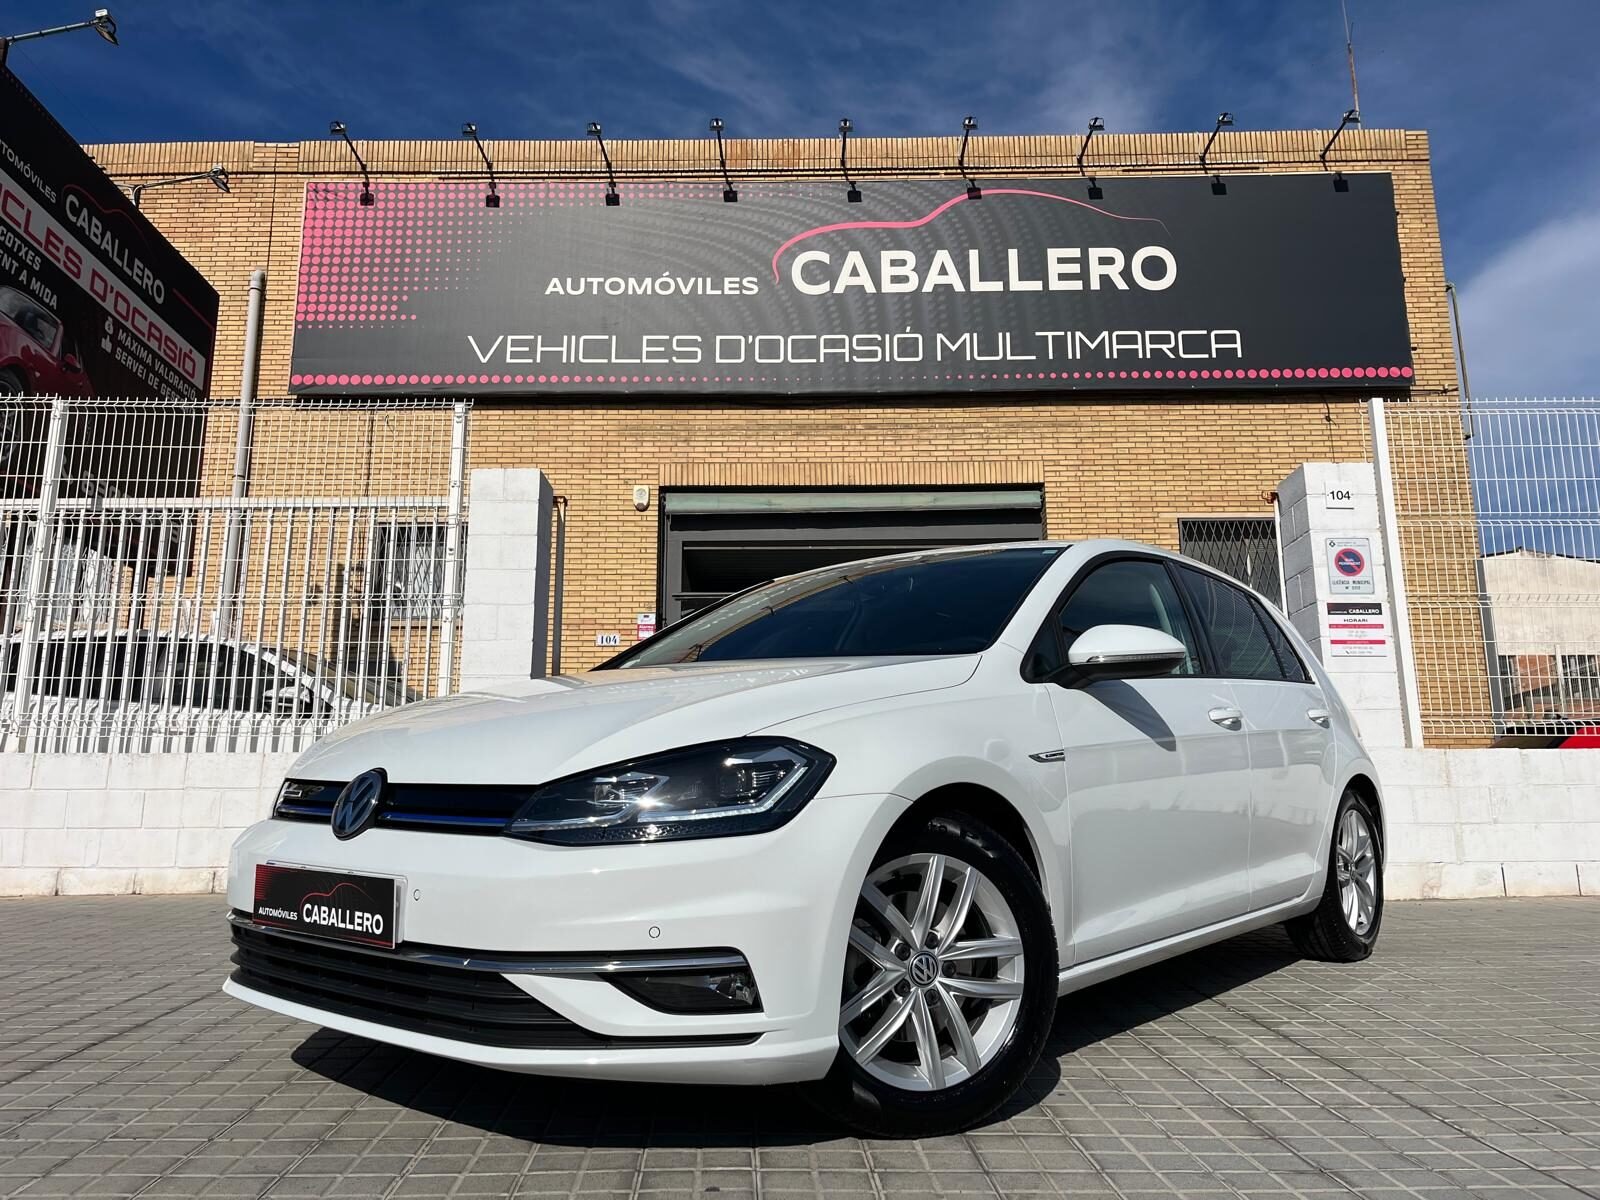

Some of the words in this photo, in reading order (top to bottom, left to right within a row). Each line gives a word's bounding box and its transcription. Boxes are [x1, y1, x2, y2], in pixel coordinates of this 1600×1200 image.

[0, 139, 57, 204] TOMÓVILES
[65, 194, 165, 305] CABALLERO
[18, 269, 27, 286] A
[30, 277, 58, 310] MIDA
[544, 271, 760, 296] AUTOMÓVILES
[791, 245, 1178, 295] CABALLERO
[89, 267, 197, 380] D'OCASIÓ
[467, 334, 702, 364] VEHICLES
[715, 326, 924, 364] D'OCASIÓ
[936, 328, 1243, 362] MULTIMARCA
[115, 346, 147, 380] SERVEI
[147, 372, 159, 389] DE
[155, 358, 196, 401] VALORACIÓ
[1329, 490, 1352, 501] 104
[600, 634, 617, 645] 104
[258, 906, 298, 921] AUTOMÓVILES
[302, 903, 384, 935] CABALLERO
